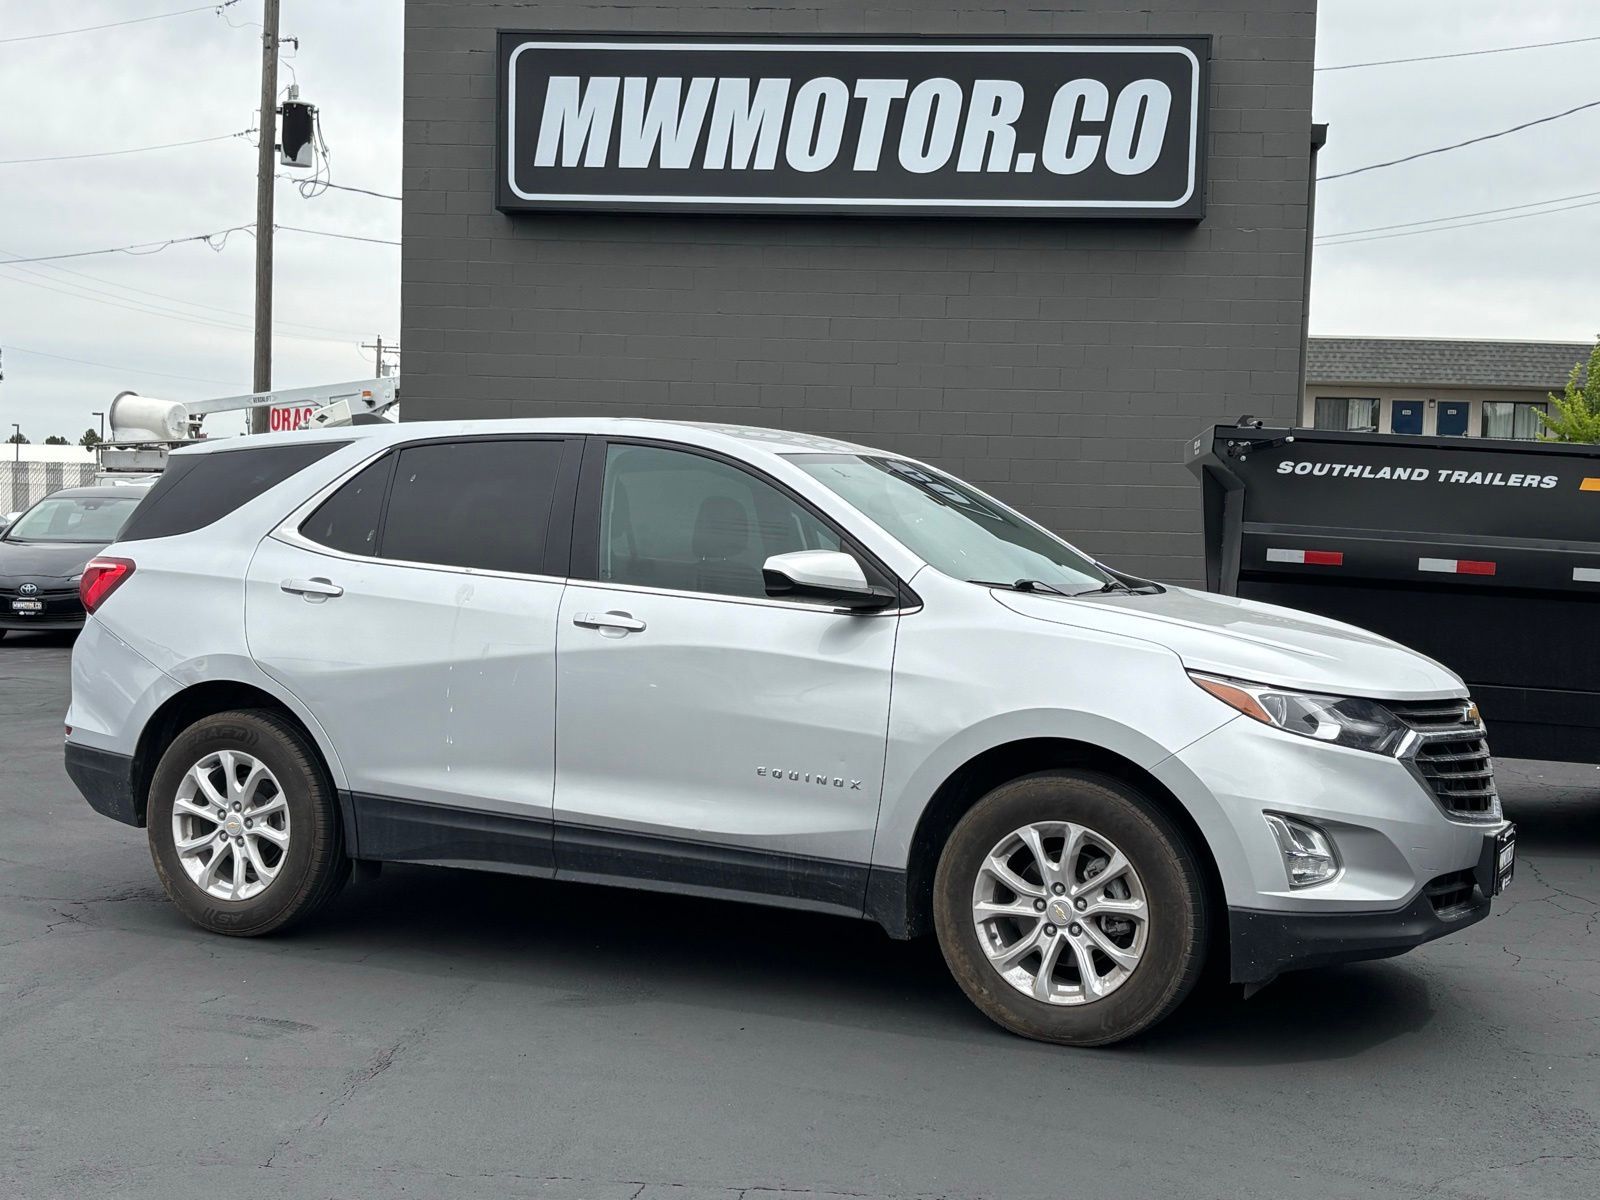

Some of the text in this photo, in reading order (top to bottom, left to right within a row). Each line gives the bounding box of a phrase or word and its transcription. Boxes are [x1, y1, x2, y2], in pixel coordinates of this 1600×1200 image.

[534, 76, 1173, 176] MWMOTOR.CO
[1276, 461, 1559, 489] SOUTHLAND TRAILERS
[756, 766, 862, 791] EQUINOX
